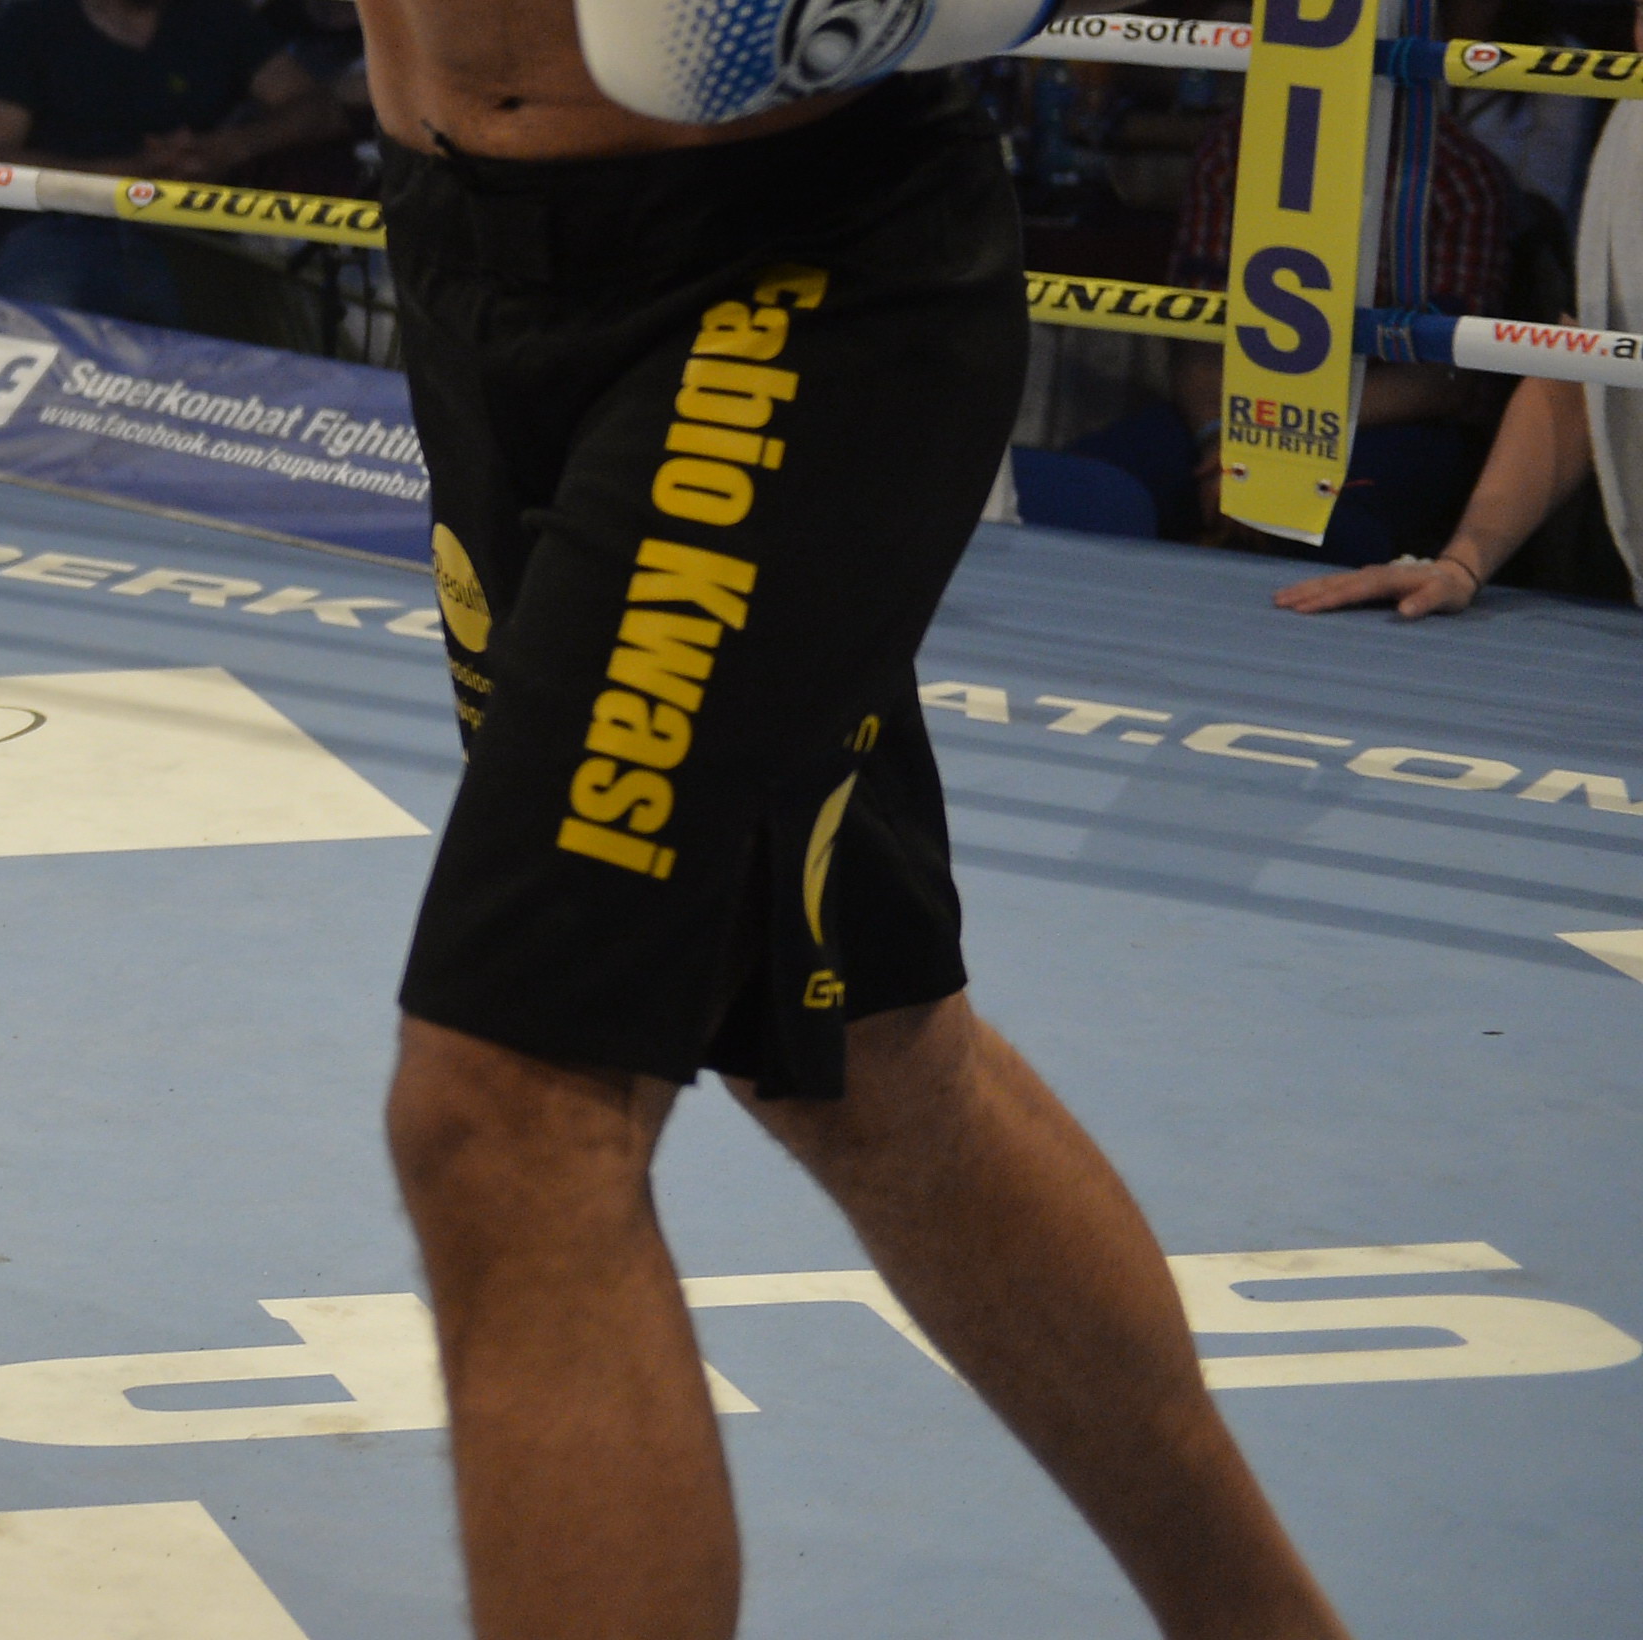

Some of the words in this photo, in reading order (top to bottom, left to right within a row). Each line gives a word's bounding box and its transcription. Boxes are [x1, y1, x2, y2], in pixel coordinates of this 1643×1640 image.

[1048, 16, 1252, 51] uto-soft.ro
[177, 188, 385, 233] DUNLO
[63, 358, 312, 441] Superkombat
[301, 406, 430, 475] Fightin
[1229, 395, 1341, 439] REDIS
[555, 537, 760, 881] Kwasi
